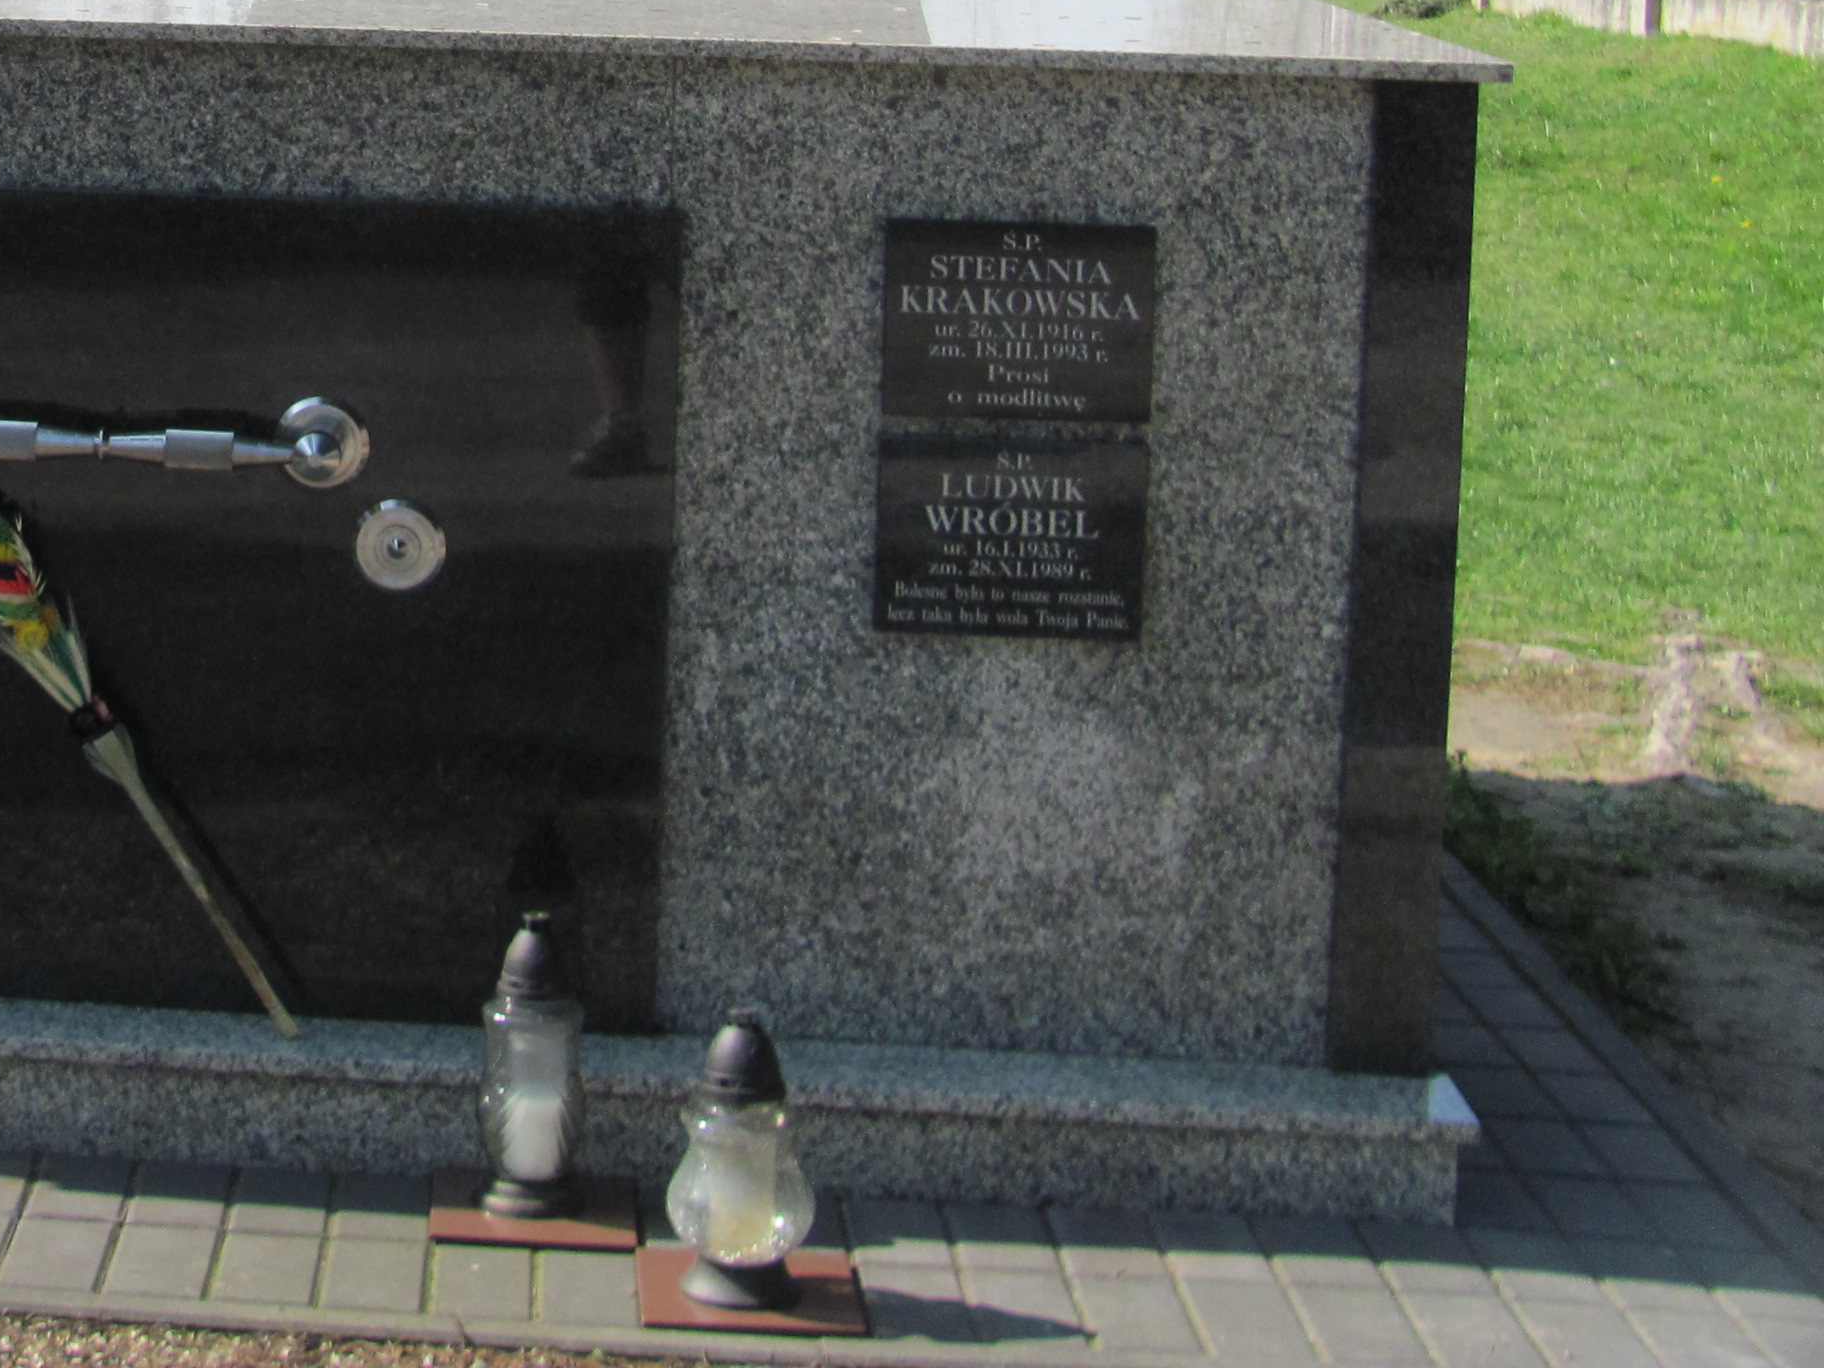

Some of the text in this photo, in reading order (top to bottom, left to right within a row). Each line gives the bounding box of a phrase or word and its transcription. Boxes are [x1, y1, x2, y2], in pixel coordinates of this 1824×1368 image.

[930, 255, 1112, 284] STEFANIA
[900, 286, 1141, 320] KRAKOWSKA
[934, 322, 960, 338] ur.
[1091, 328, 1104, 342] r.
[929, 342, 966, 358] zm.
[1096, 348, 1108, 363] r.
[988, 364, 1050, 384] Prosi
[948, 392, 962, 404] o
[940, 473, 1086, 502] LUDWIK
[926, 501, 1100, 540] WRÓBEL
[944, 542, 967, 556] ur.
[928, 562, 962, 576] zm.
